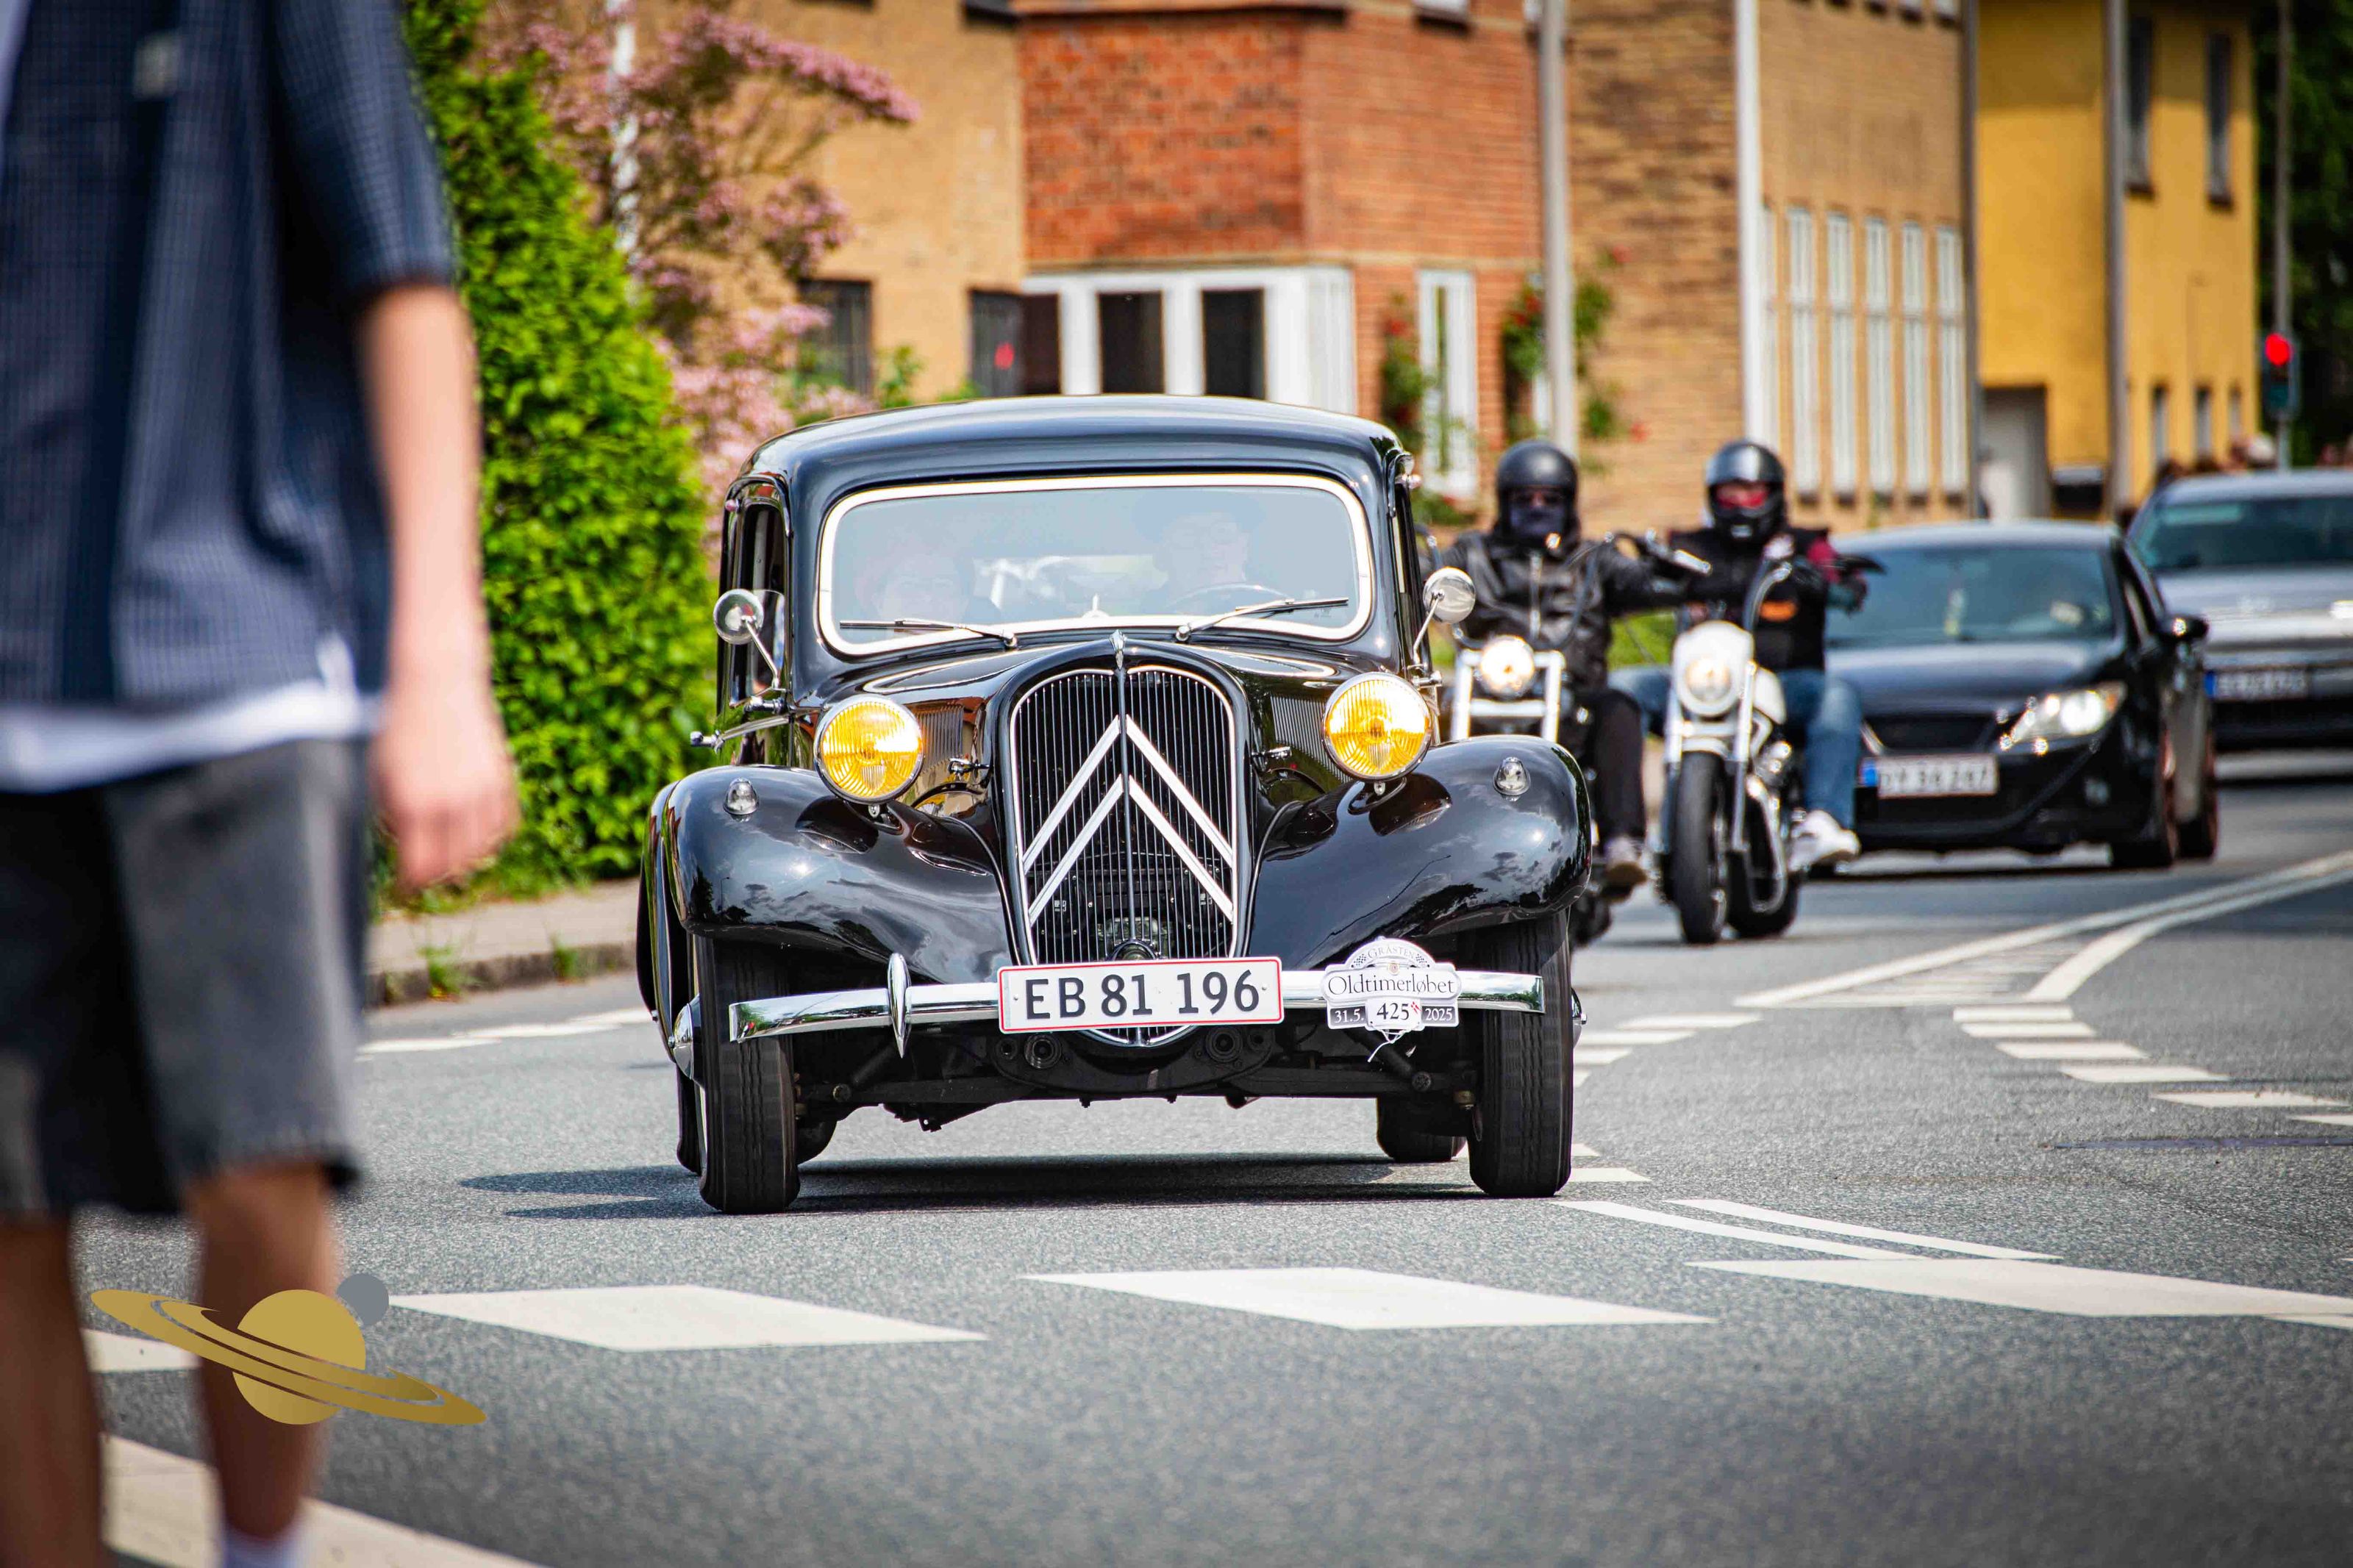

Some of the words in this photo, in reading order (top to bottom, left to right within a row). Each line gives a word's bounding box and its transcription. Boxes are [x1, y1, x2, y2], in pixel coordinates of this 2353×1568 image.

[1327, 973, 1455, 995] Oldtimerløbet
[1026, 977, 1086, 1020] EB
[1101, 974, 1153, 1017] 81
[1176, 969, 1260, 1014] 196
[1334, 1008, 1364, 1023] 31.5.
[1377, 1002, 1410, 1020] 425
[1424, 1008, 1453, 1022] 2025
